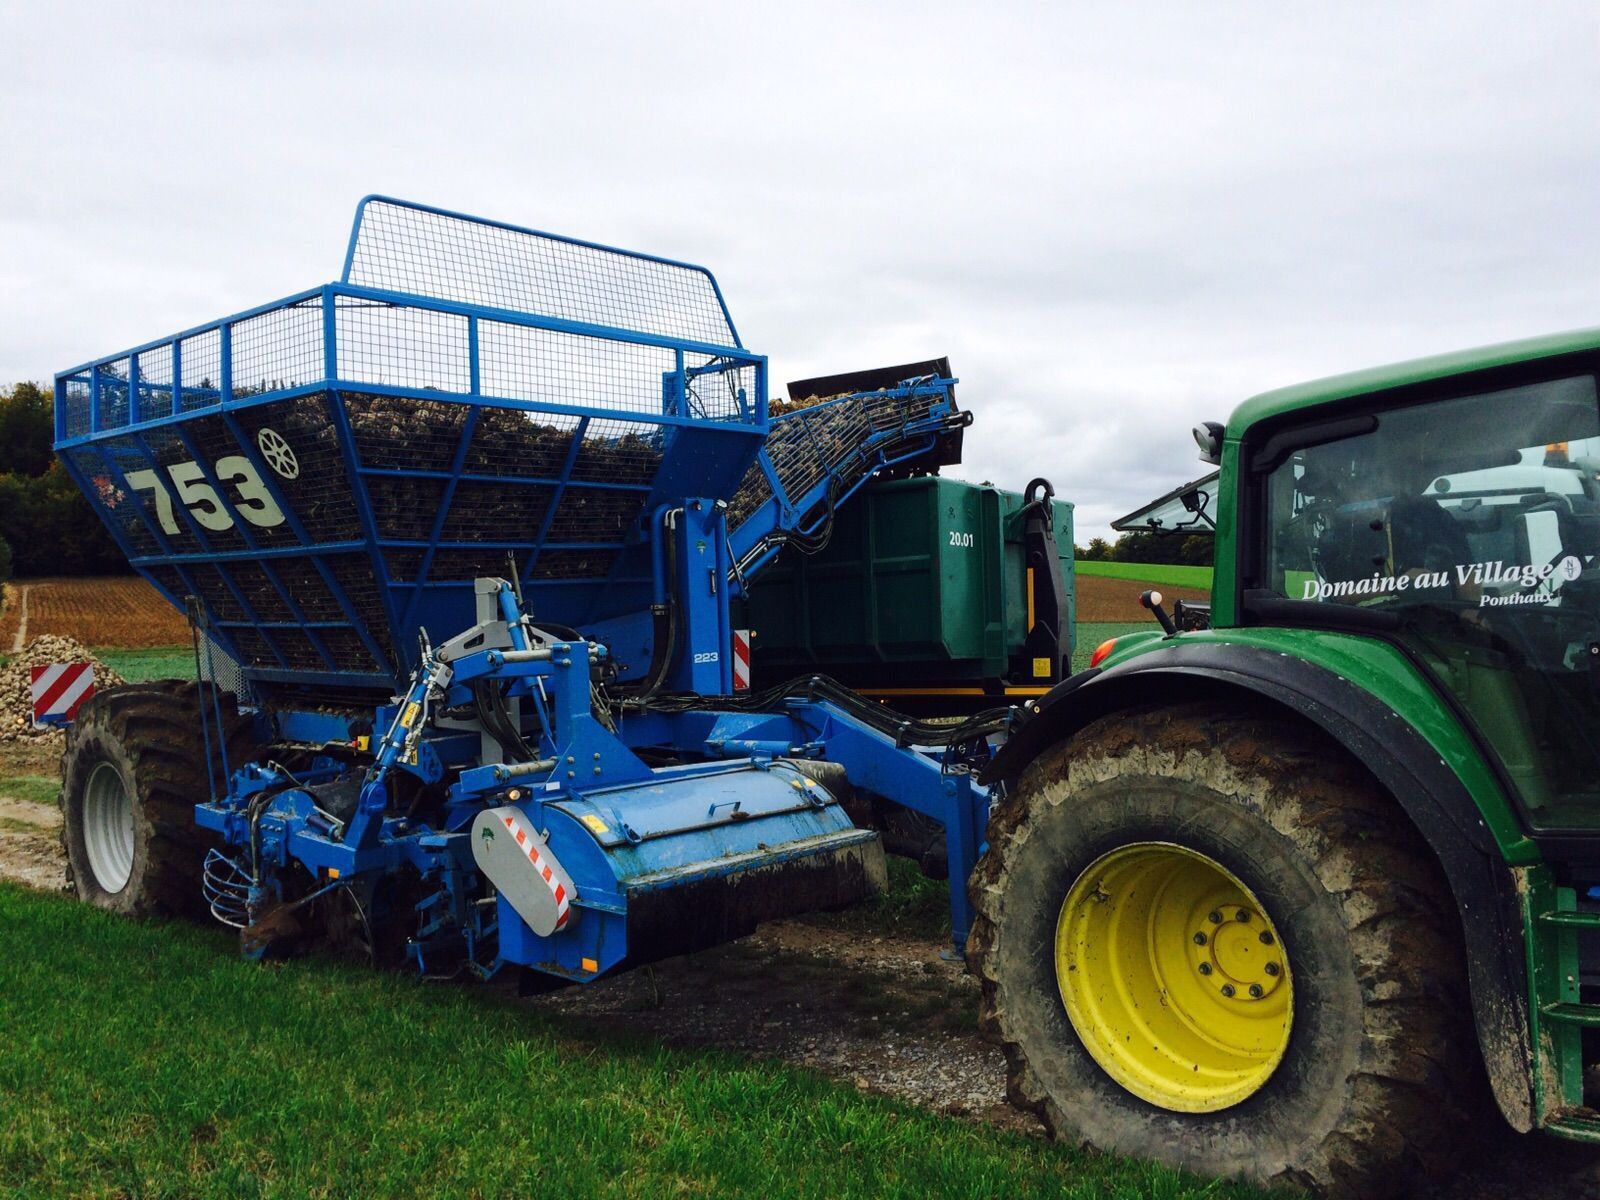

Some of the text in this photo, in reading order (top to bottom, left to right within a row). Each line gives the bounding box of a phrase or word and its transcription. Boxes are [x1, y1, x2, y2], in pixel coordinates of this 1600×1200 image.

[124, 455, 286, 535] 753
[949, 531, 974, 548] 20.01
[1302, 572, 1410, 600] Domaine
[1414, 570, 1449, 590] au
[1455, 560, 1554, 587] Village
[1479, 591, 1554, 607] Ponthaux
[693, 651, 719, 664] 223
